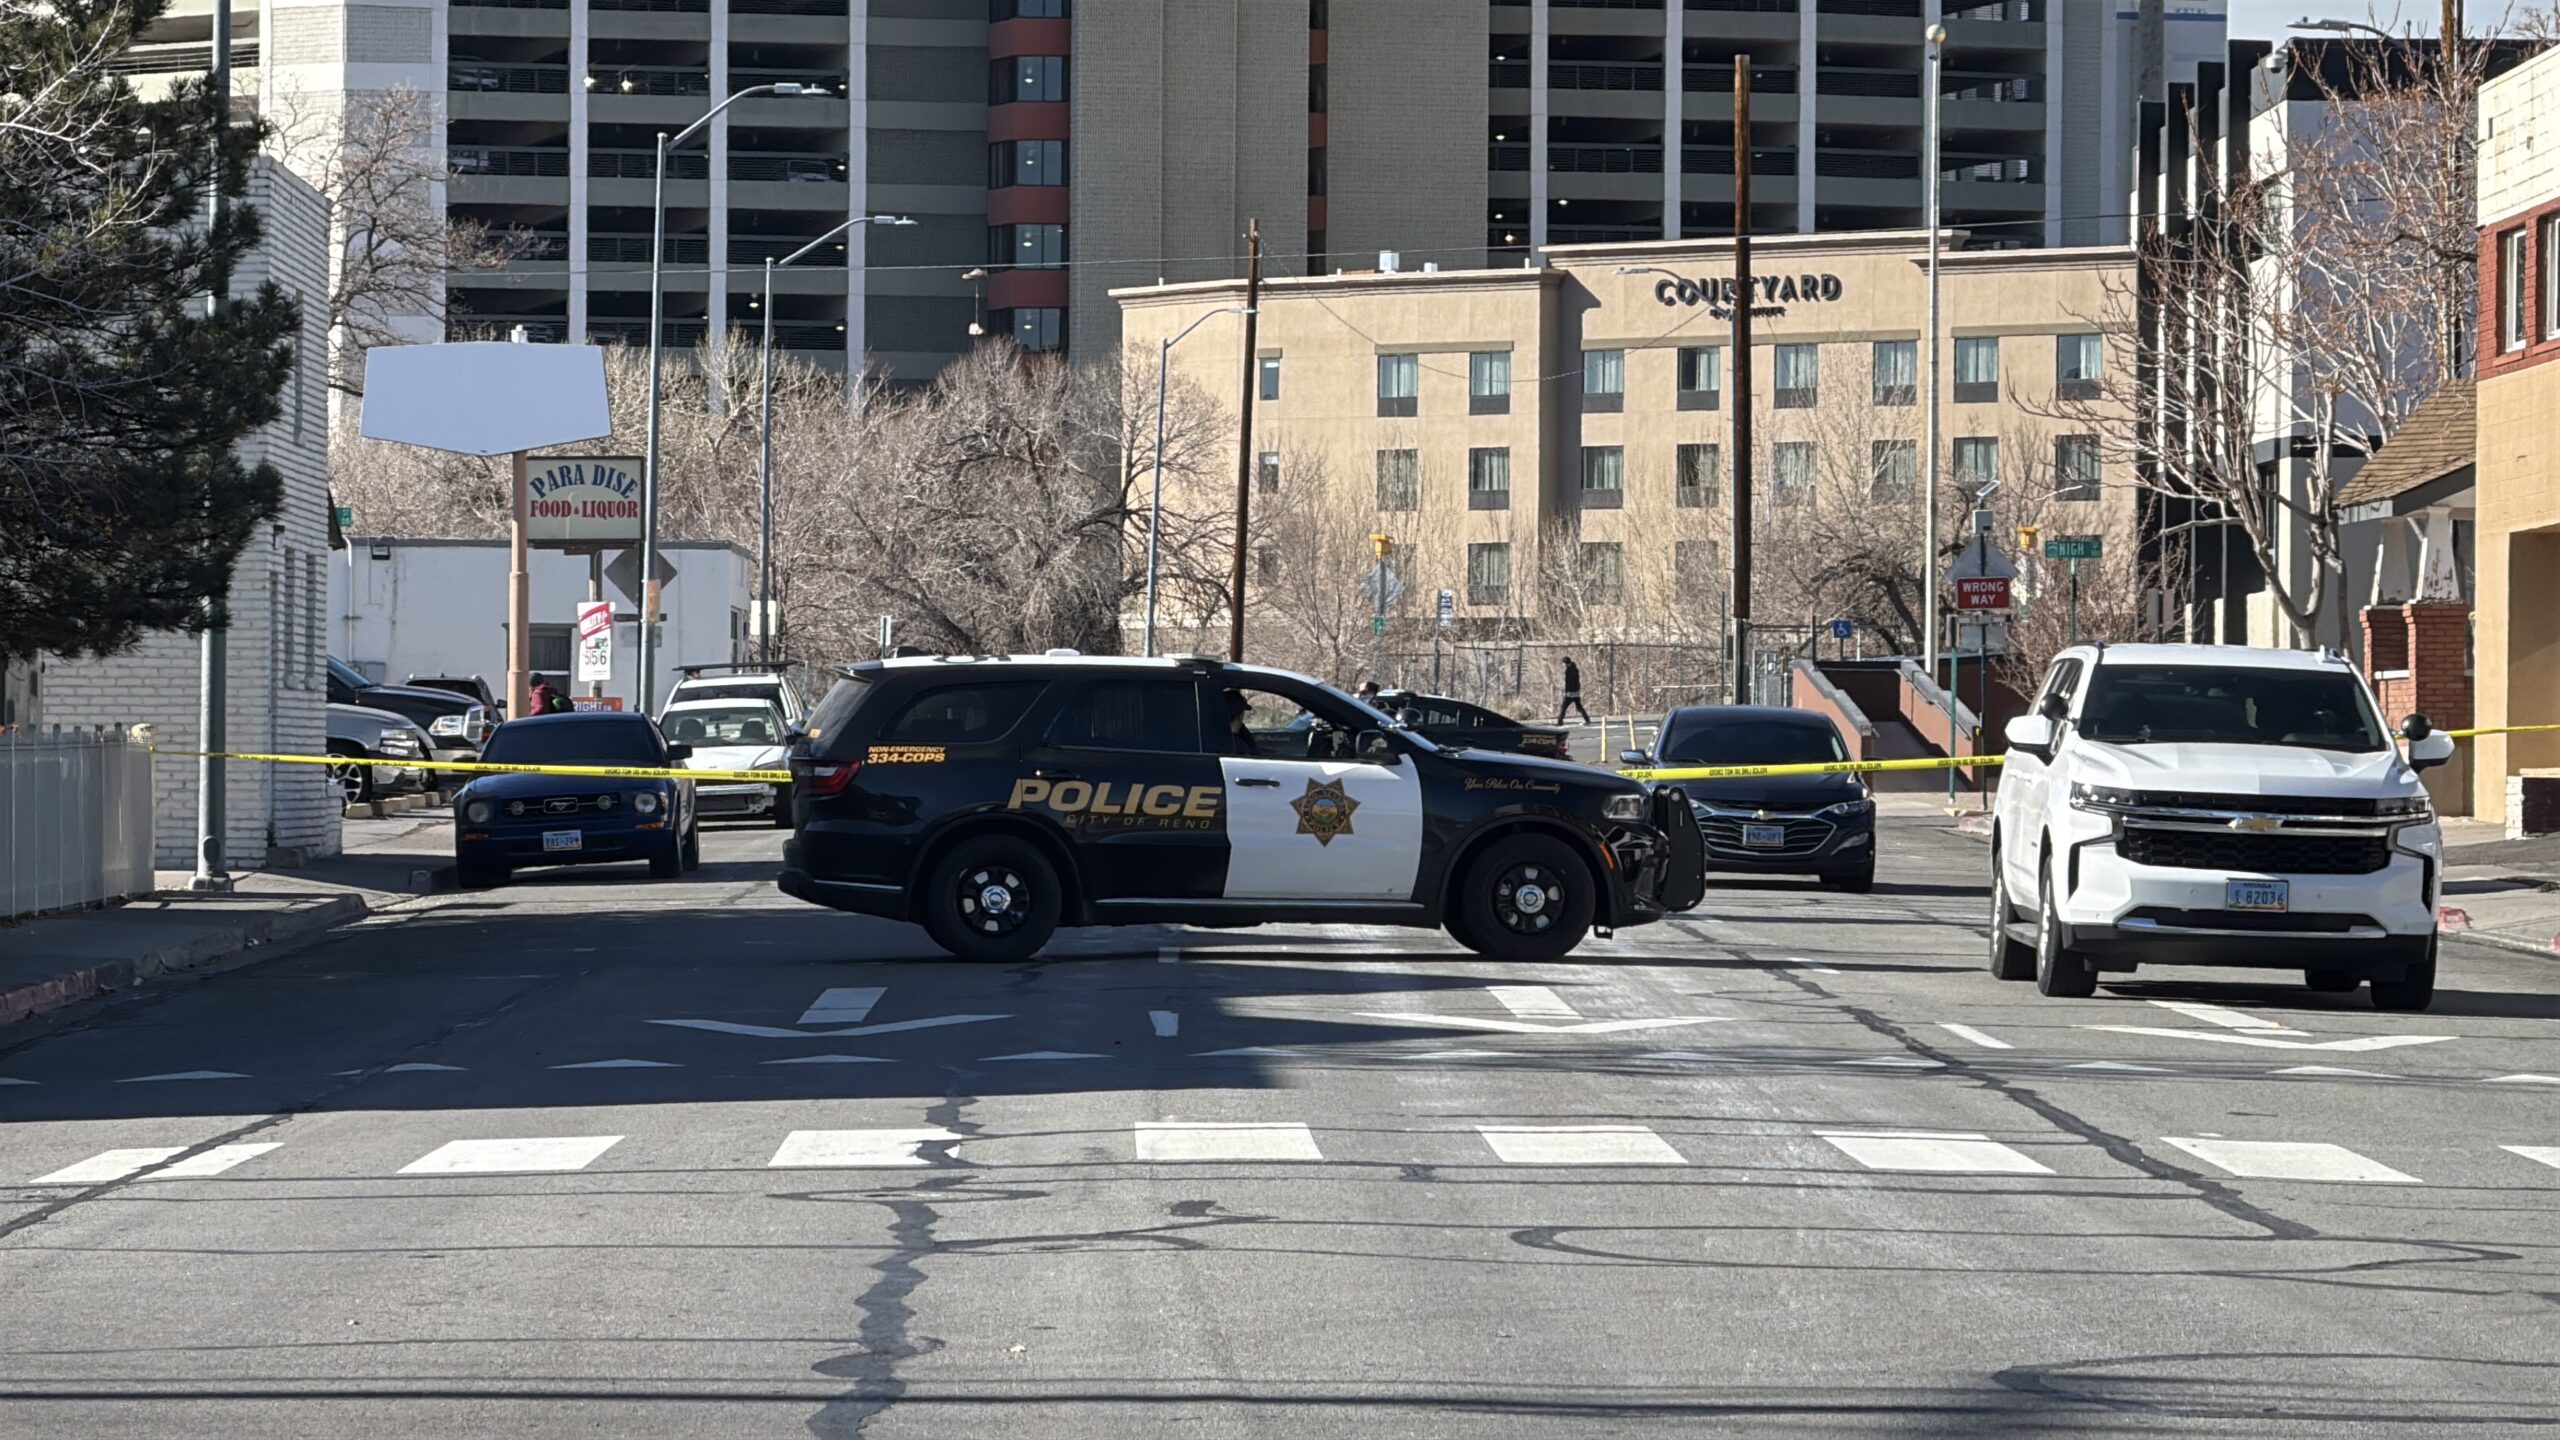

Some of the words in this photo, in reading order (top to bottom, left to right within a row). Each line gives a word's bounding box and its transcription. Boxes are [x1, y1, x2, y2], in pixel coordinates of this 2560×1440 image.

[529, 464, 585, 499] PARA
[592, 464, 638, 499] DISE
[530, 501, 572, 518] FOOD
[582, 501, 638, 520] LIQUOR
[2059, 543, 2084, 556] HIGH
[1962, 581, 2005, 592] WRONG
[1970, 594, 1996, 605] WAY
[868, 745, 946, 753] NON-EMERGENCY
[867, 753, 946, 764] 334-COPS
[1007, 779, 1222, 817] POLICE
[1065, 814, 1111, 824] CITY
[1123, 816, 1146, 826] OF
[1159, 818, 1211, 829] RENO
[2247, 890, 2284, 905] 82036
